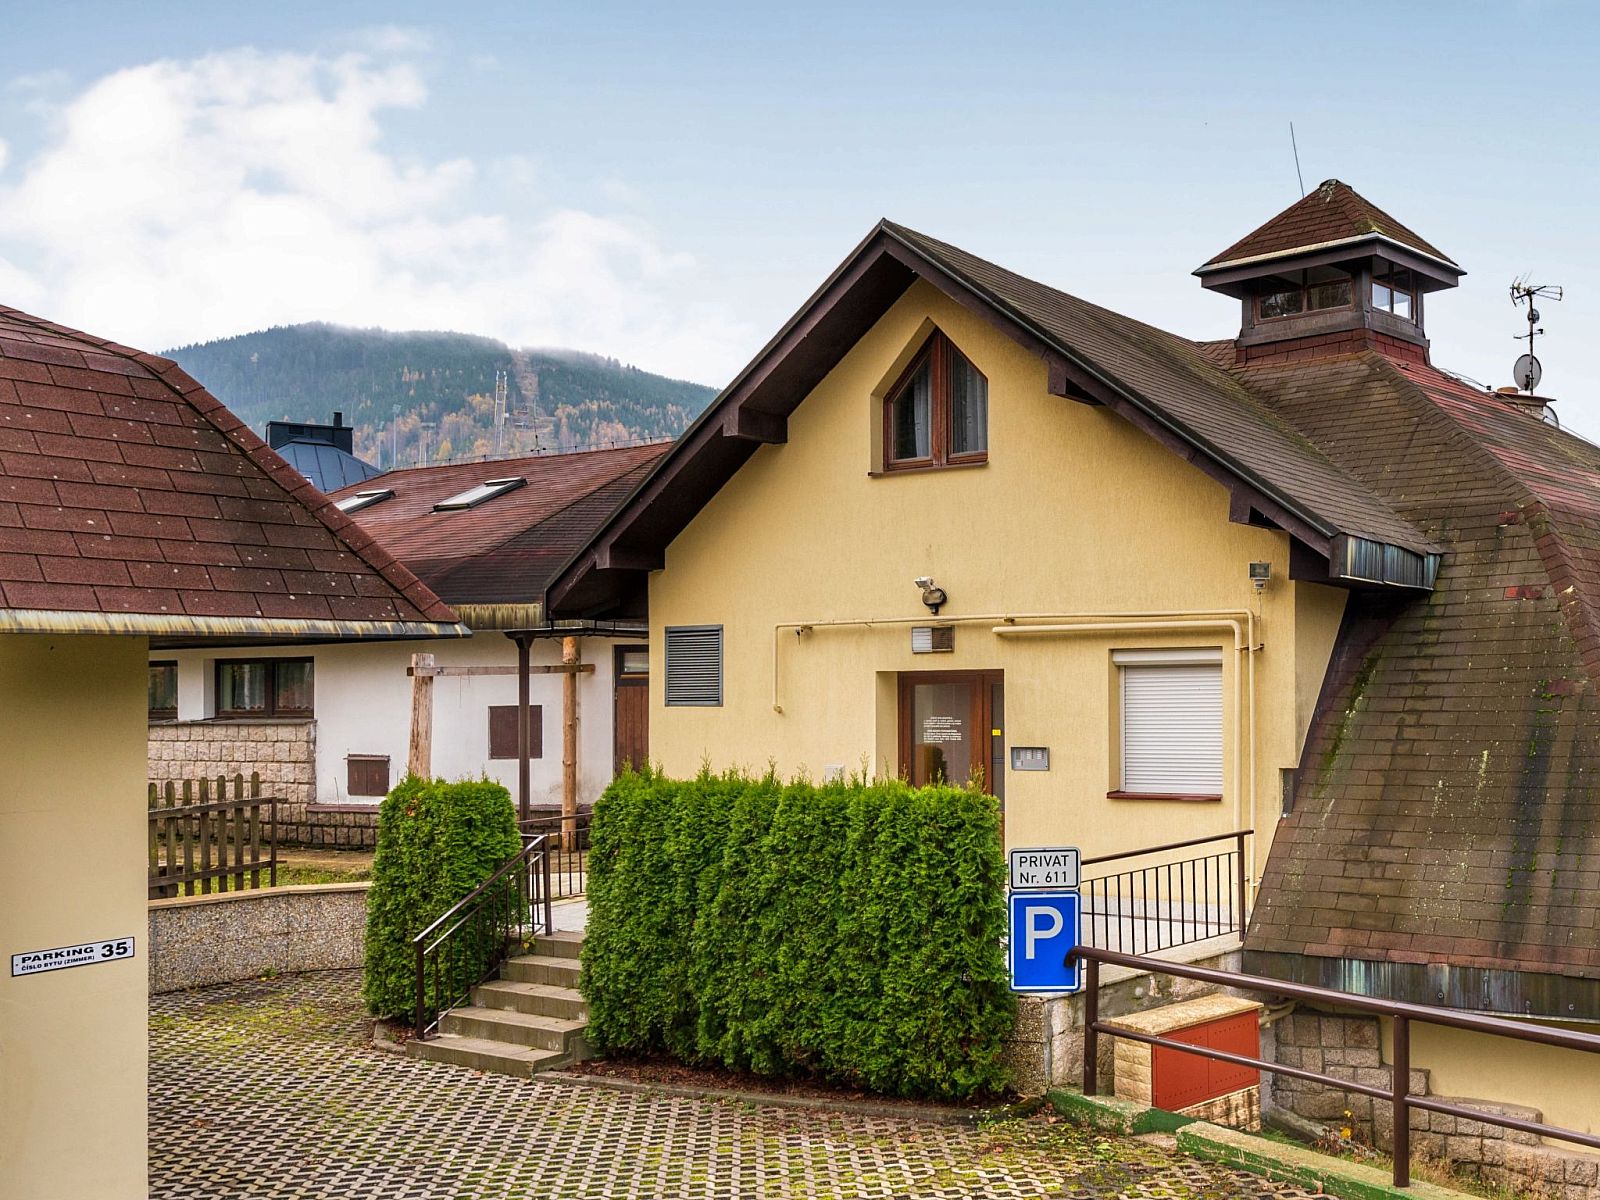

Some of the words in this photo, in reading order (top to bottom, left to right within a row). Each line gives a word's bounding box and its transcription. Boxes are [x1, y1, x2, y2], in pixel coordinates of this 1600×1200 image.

[1019, 855, 1069, 867] PRIVAT
[1020, 871, 1039, 884] Nr.
[1045, 871, 1067, 883] 611
[1025, 905, 1064, 960] P
[22, 947, 94, 963] PARKING
[101, 941, 128, 958] 35
[21, 962, 42, 971] ČÍSLO
[44, 960, 63, 968] BYTU
